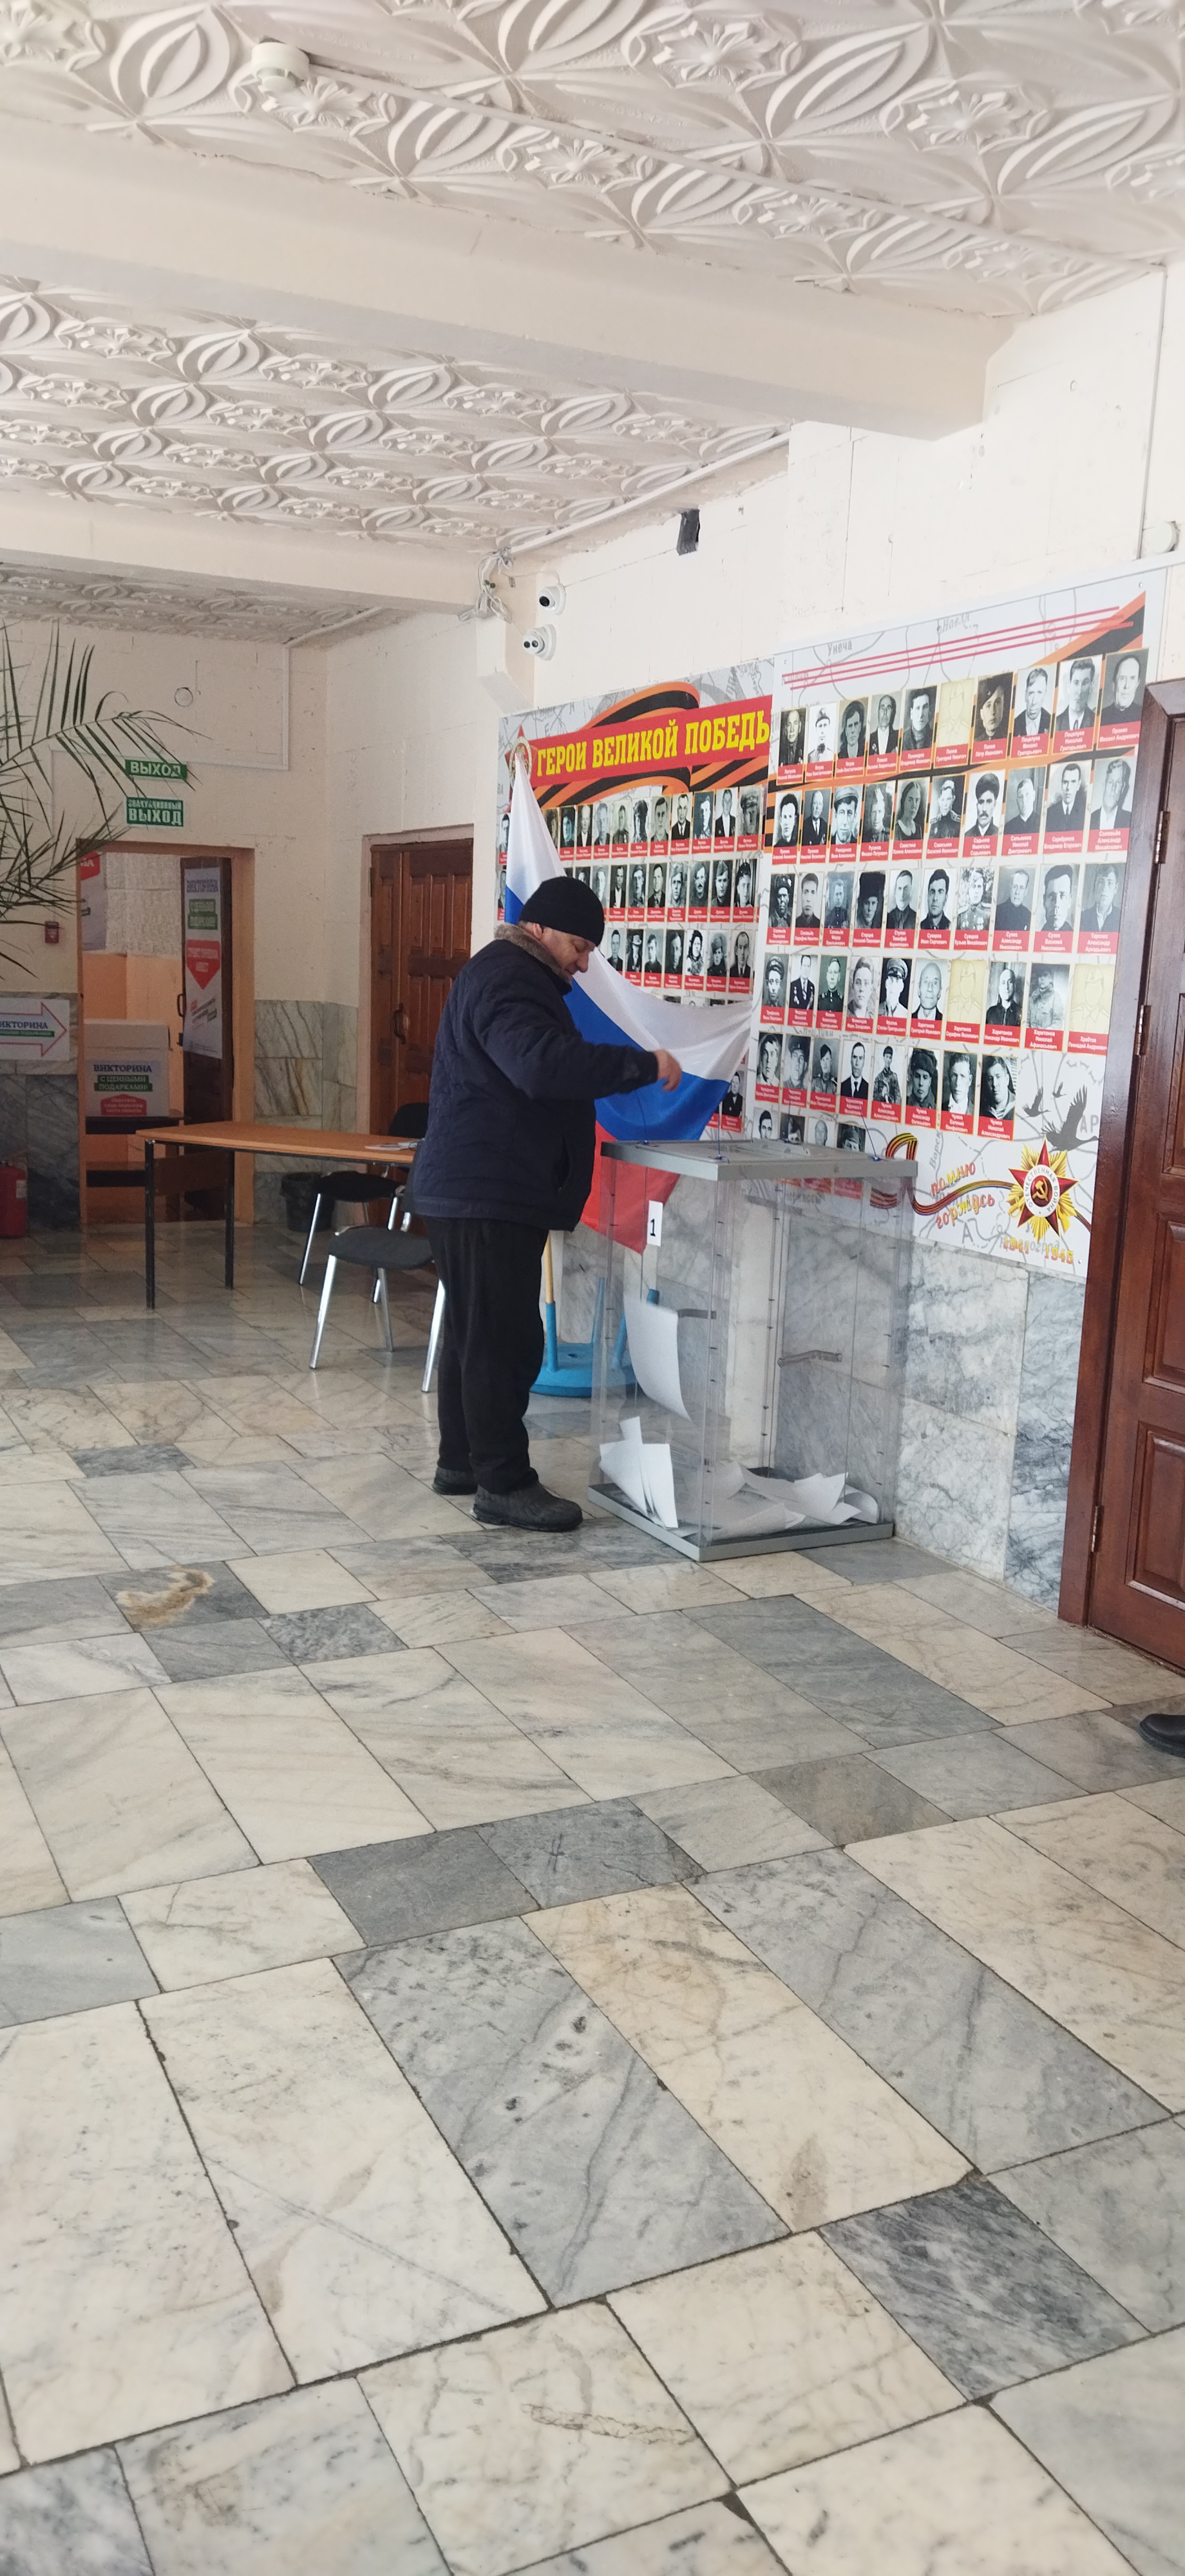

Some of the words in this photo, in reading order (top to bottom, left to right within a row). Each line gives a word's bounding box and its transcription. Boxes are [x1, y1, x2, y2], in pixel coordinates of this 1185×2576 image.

[827, 640, 852, 656] Унеча
[537, 742, 587, 777] ГЕРОИ
[592, 719, 679, 768] ВЕЛИКОЙ
[130, 761, 180, 777] ВЫХОД
[128, 808, 182, 826] ВЫХОД
[93, 1064, 153, 1073] ВИКТОРИНА
[931, 1162, 976, 1196] помню
[1025, 1167, 1056, 1208] ОТЕЧЕСТВЕННАЯ
[1047, 1185, 1059, 1213] ВОЙНА
[936, 1193, 996, 1229] горжусь
[650, 1218, 656, 1237] 1
[1003, 1236, 1029, 1255] 1941
[1045, 1245, 1074, 1265] 1945
